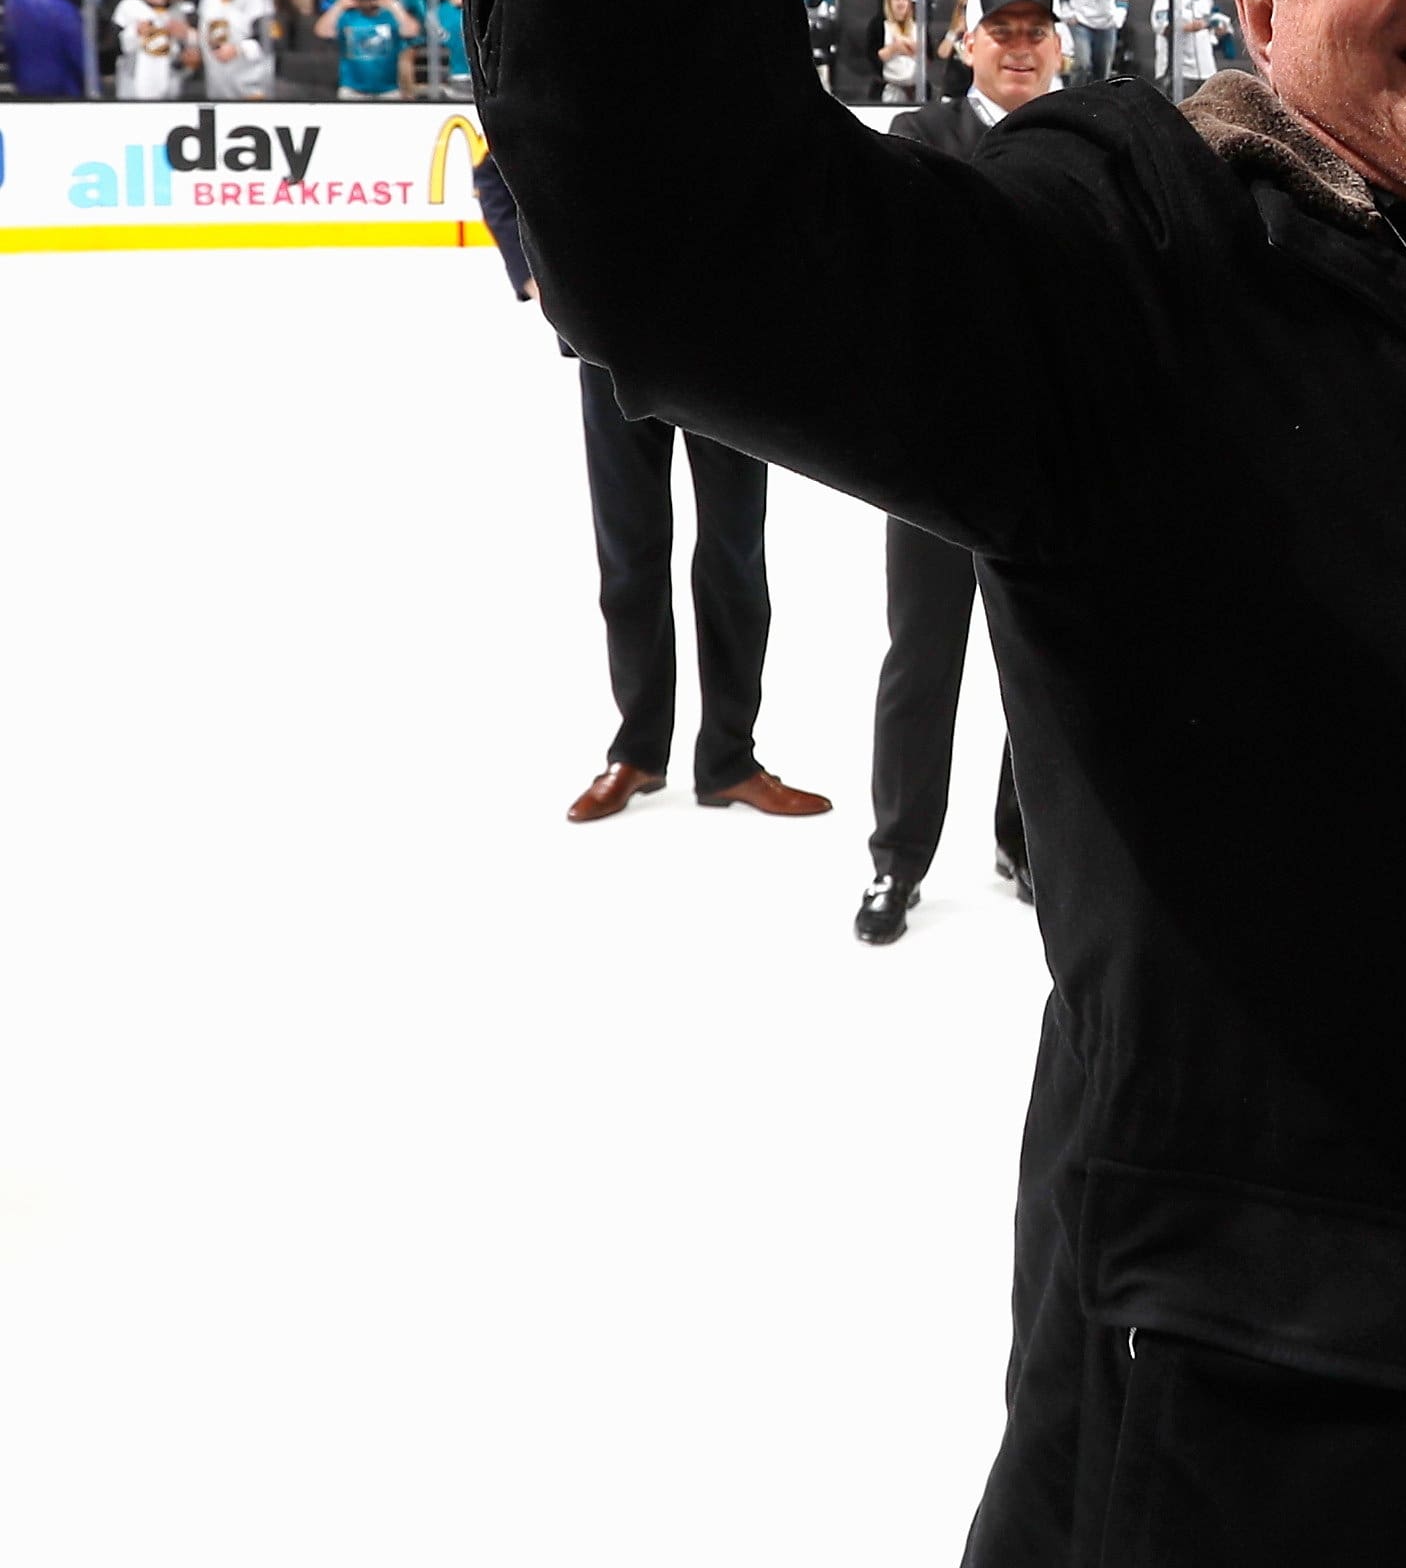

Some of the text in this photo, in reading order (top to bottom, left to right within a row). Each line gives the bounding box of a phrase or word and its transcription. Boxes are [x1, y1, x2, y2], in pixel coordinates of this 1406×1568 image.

[68, 144, 173, 208] all
[165, 105, 321, 184] day
[193, 180, 414, 206] BREAKFAST
